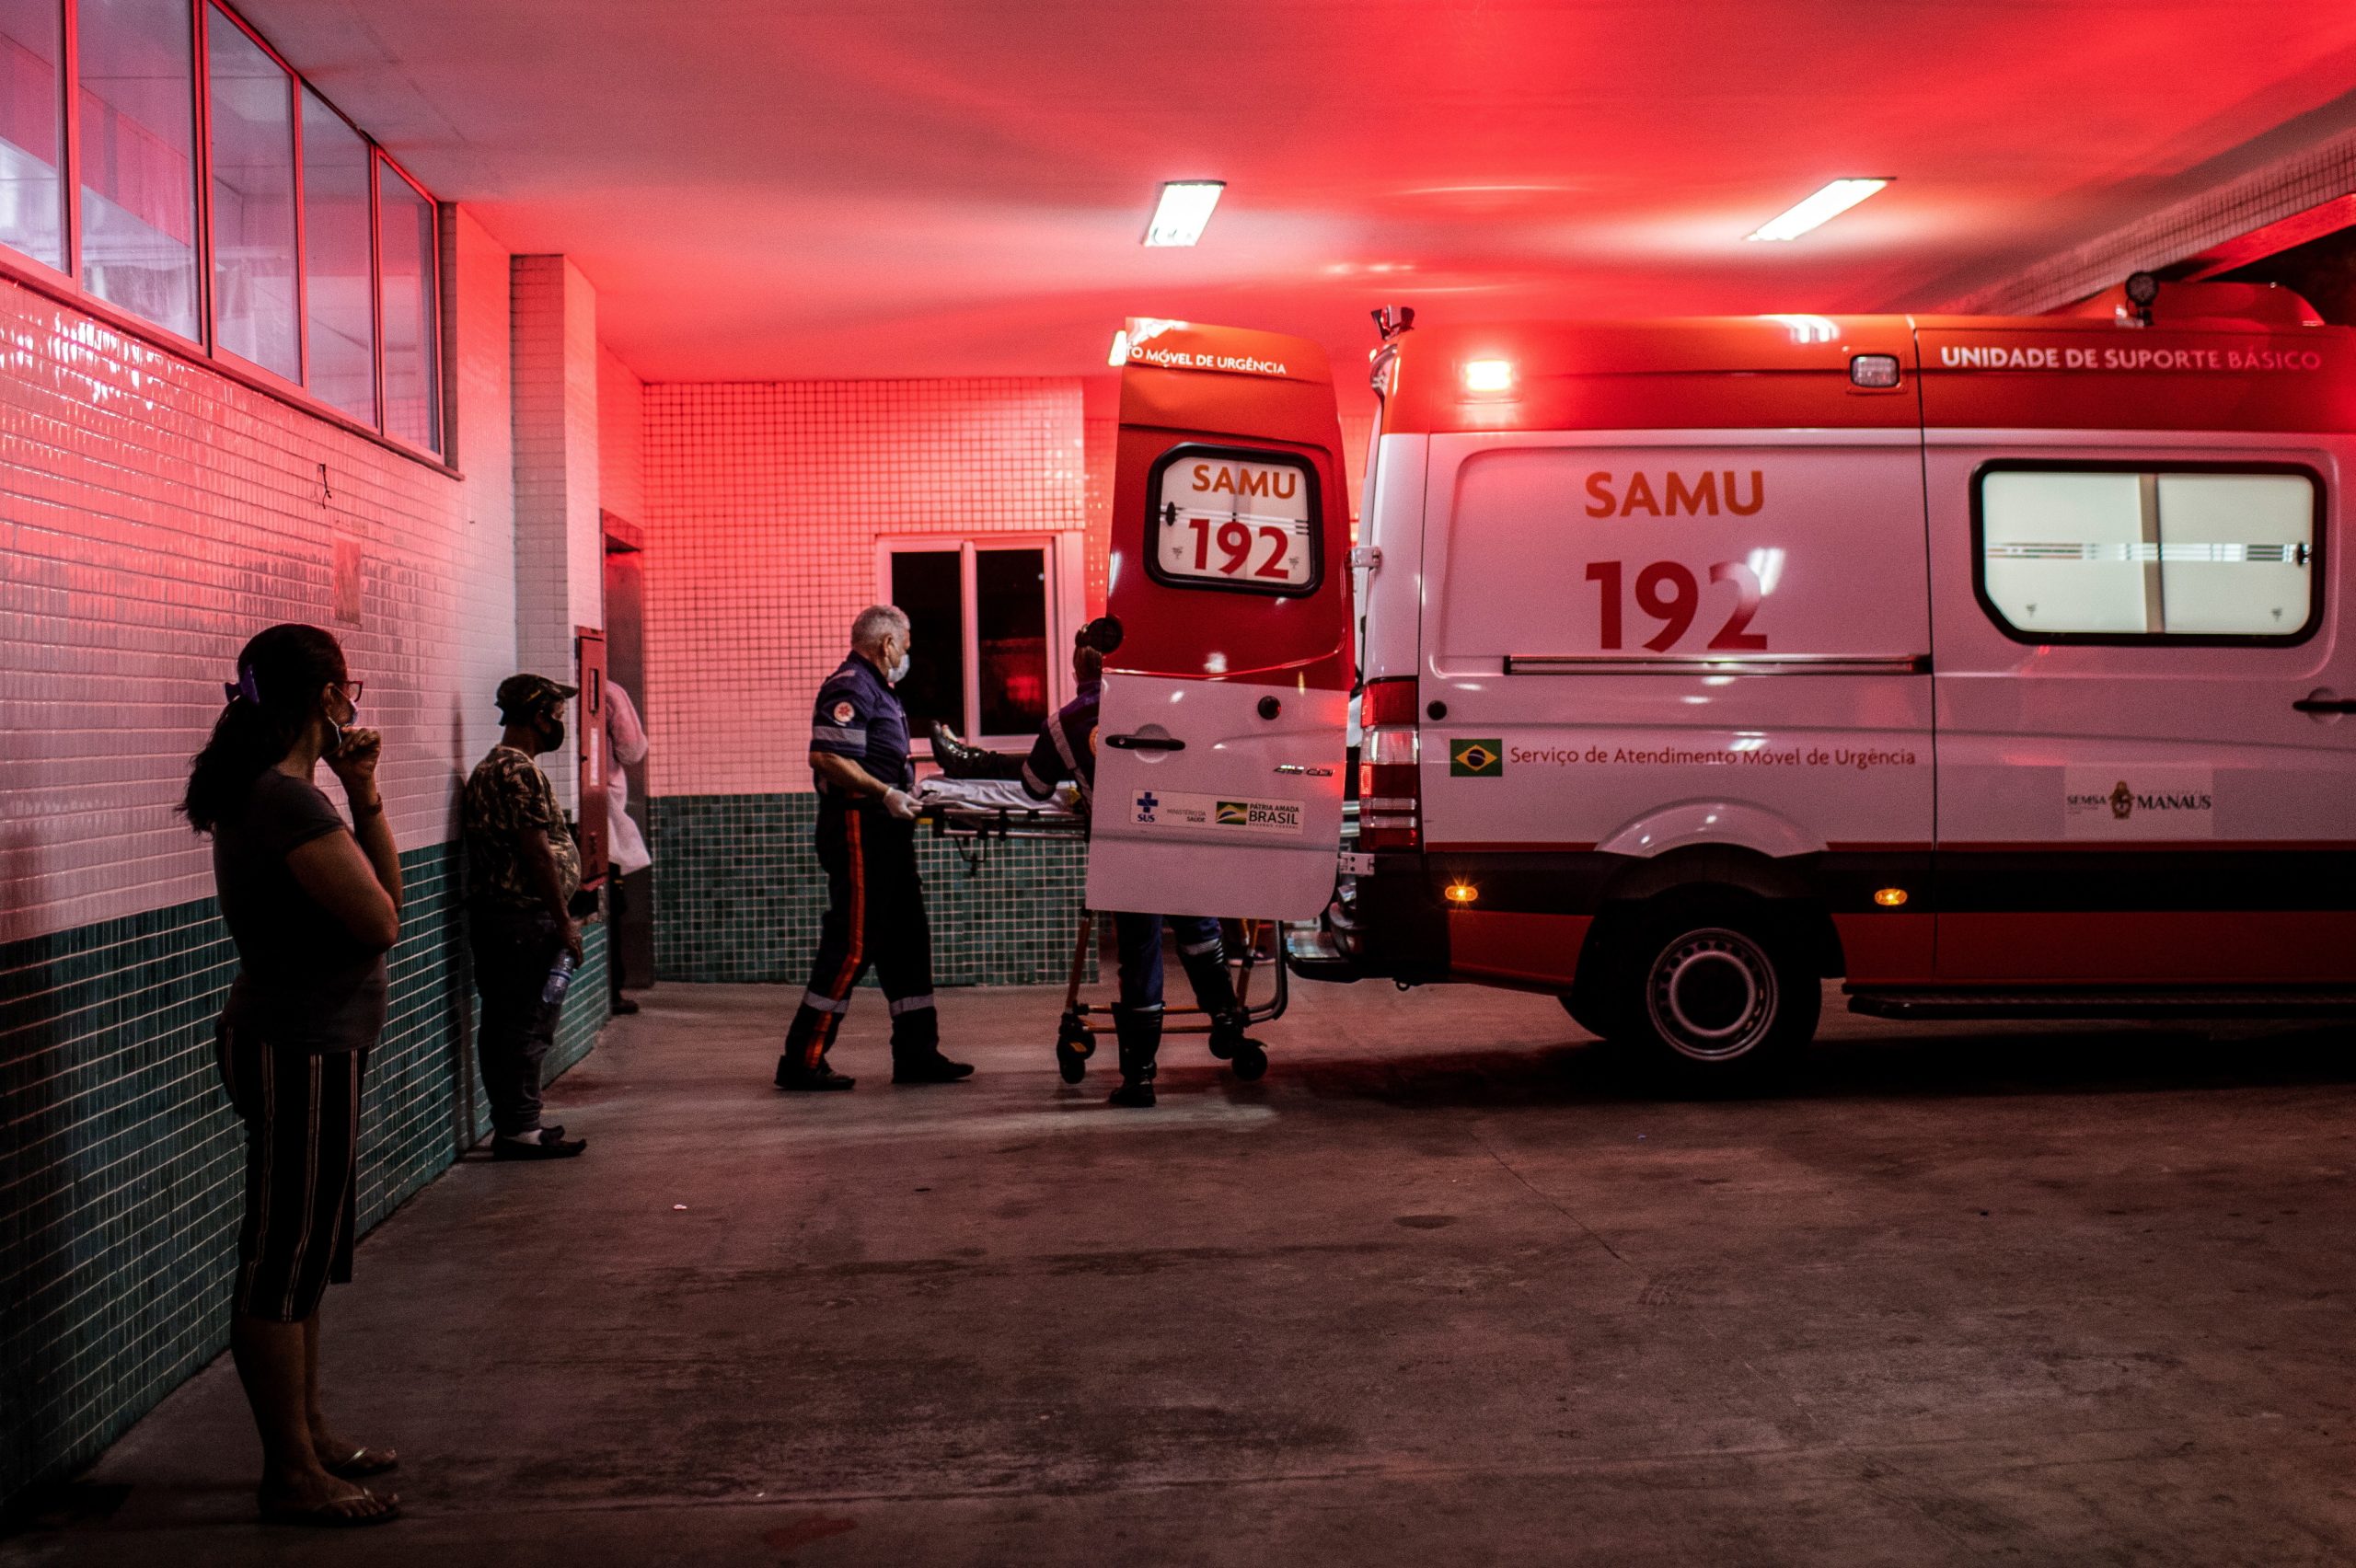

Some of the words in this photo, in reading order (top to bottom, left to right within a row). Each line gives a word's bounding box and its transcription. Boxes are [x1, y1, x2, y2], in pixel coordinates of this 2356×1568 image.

[1146, 349, 1193, 365] MÓVEL
[1196, 354, 1214, 366] DE
[1217, 356, 1287, 375] URGÊNCIA
[1941, 346, 2060, 368] UNIDADE
[2065, 348, 2098, 369] DE
[2104, 348, 2222, 369] SUPORTE
[2227, 344, 2322, 370] BÁSICO
[1192, 464, 1296, 499] SAMU
[1585, 470, 1764, 518] SAMU
[1188, 518, 1289, 579] 192
[1585, 560, 1768, 652] 192
[1509, 746, 1579, 767] Serviço
[1585, 745, 1608, 764] de
[1613, 746, 1737, 765] Atendimento
[1743, 748, 1801, 765] Móvel
[1807, 747, 1830, 766] de
[1834, 748, 1916, 770] Urgência
[2137, 794, 2212, 811] MANAUS
[1138, 813, 1155, 823] SUS
[1249, 811, 1299, 825] BRASIL
